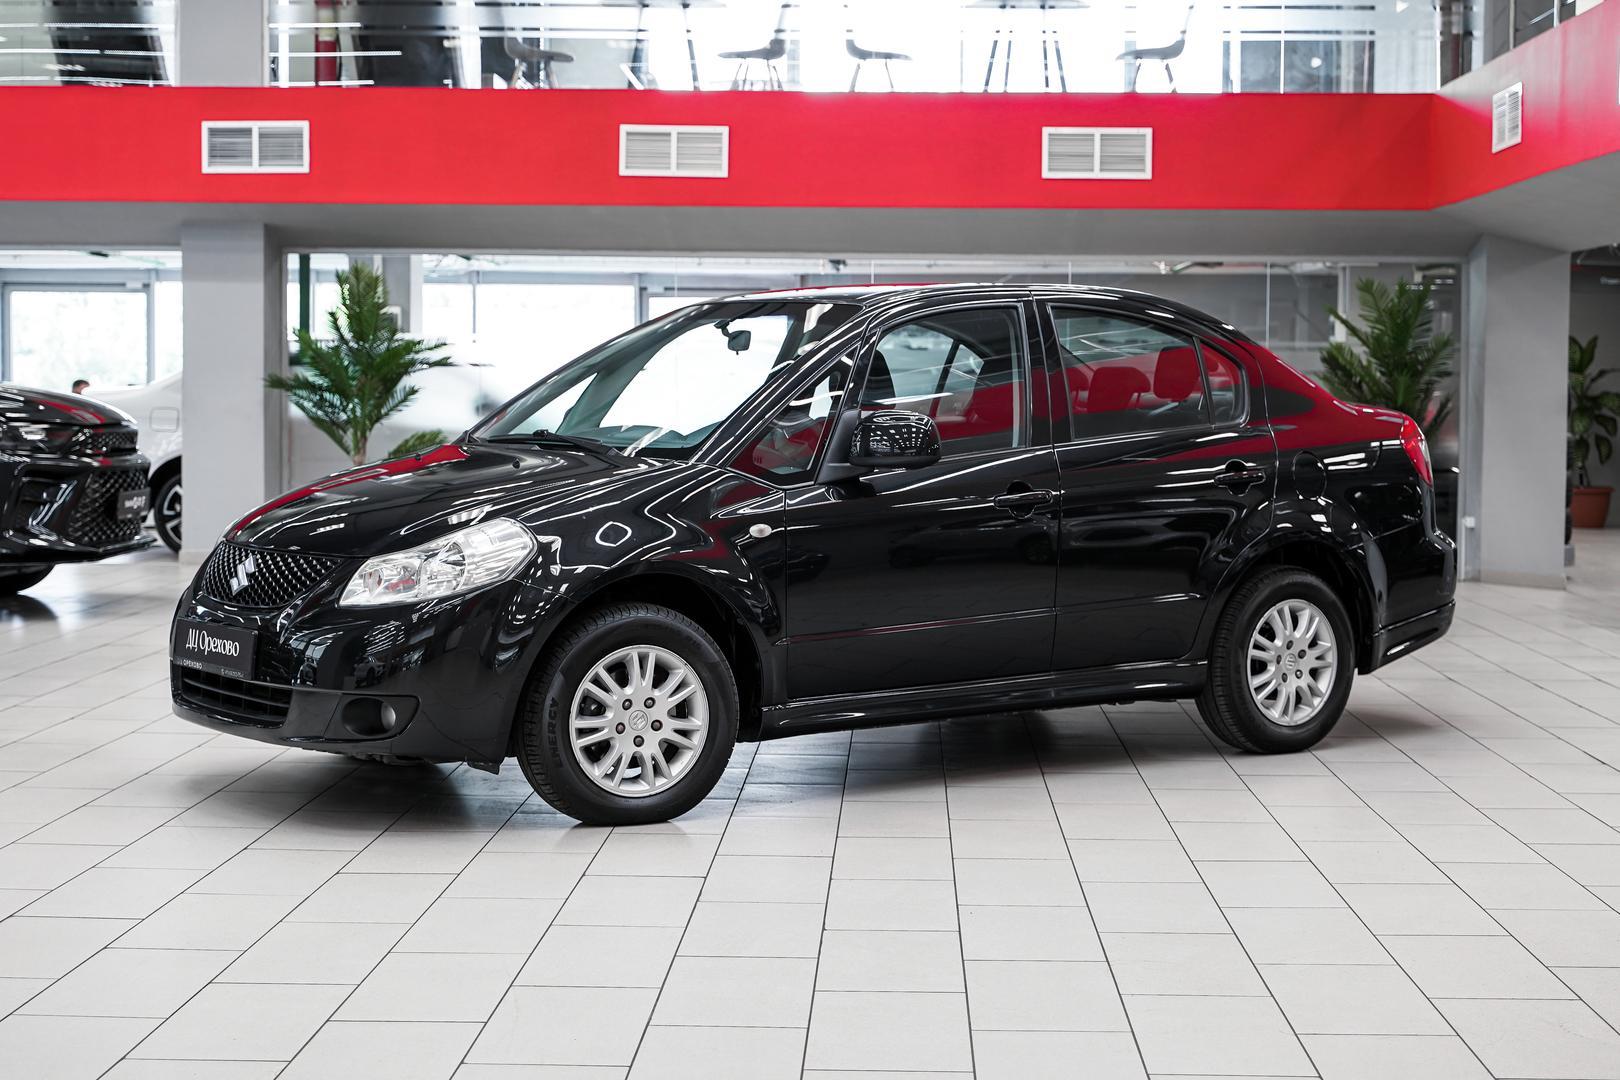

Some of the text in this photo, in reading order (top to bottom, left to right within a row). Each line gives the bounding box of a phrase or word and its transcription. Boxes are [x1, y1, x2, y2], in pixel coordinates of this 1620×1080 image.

[185, 628, 240, 657] ДЦ Орехово
[546, 696, 563, 769] NERGY
